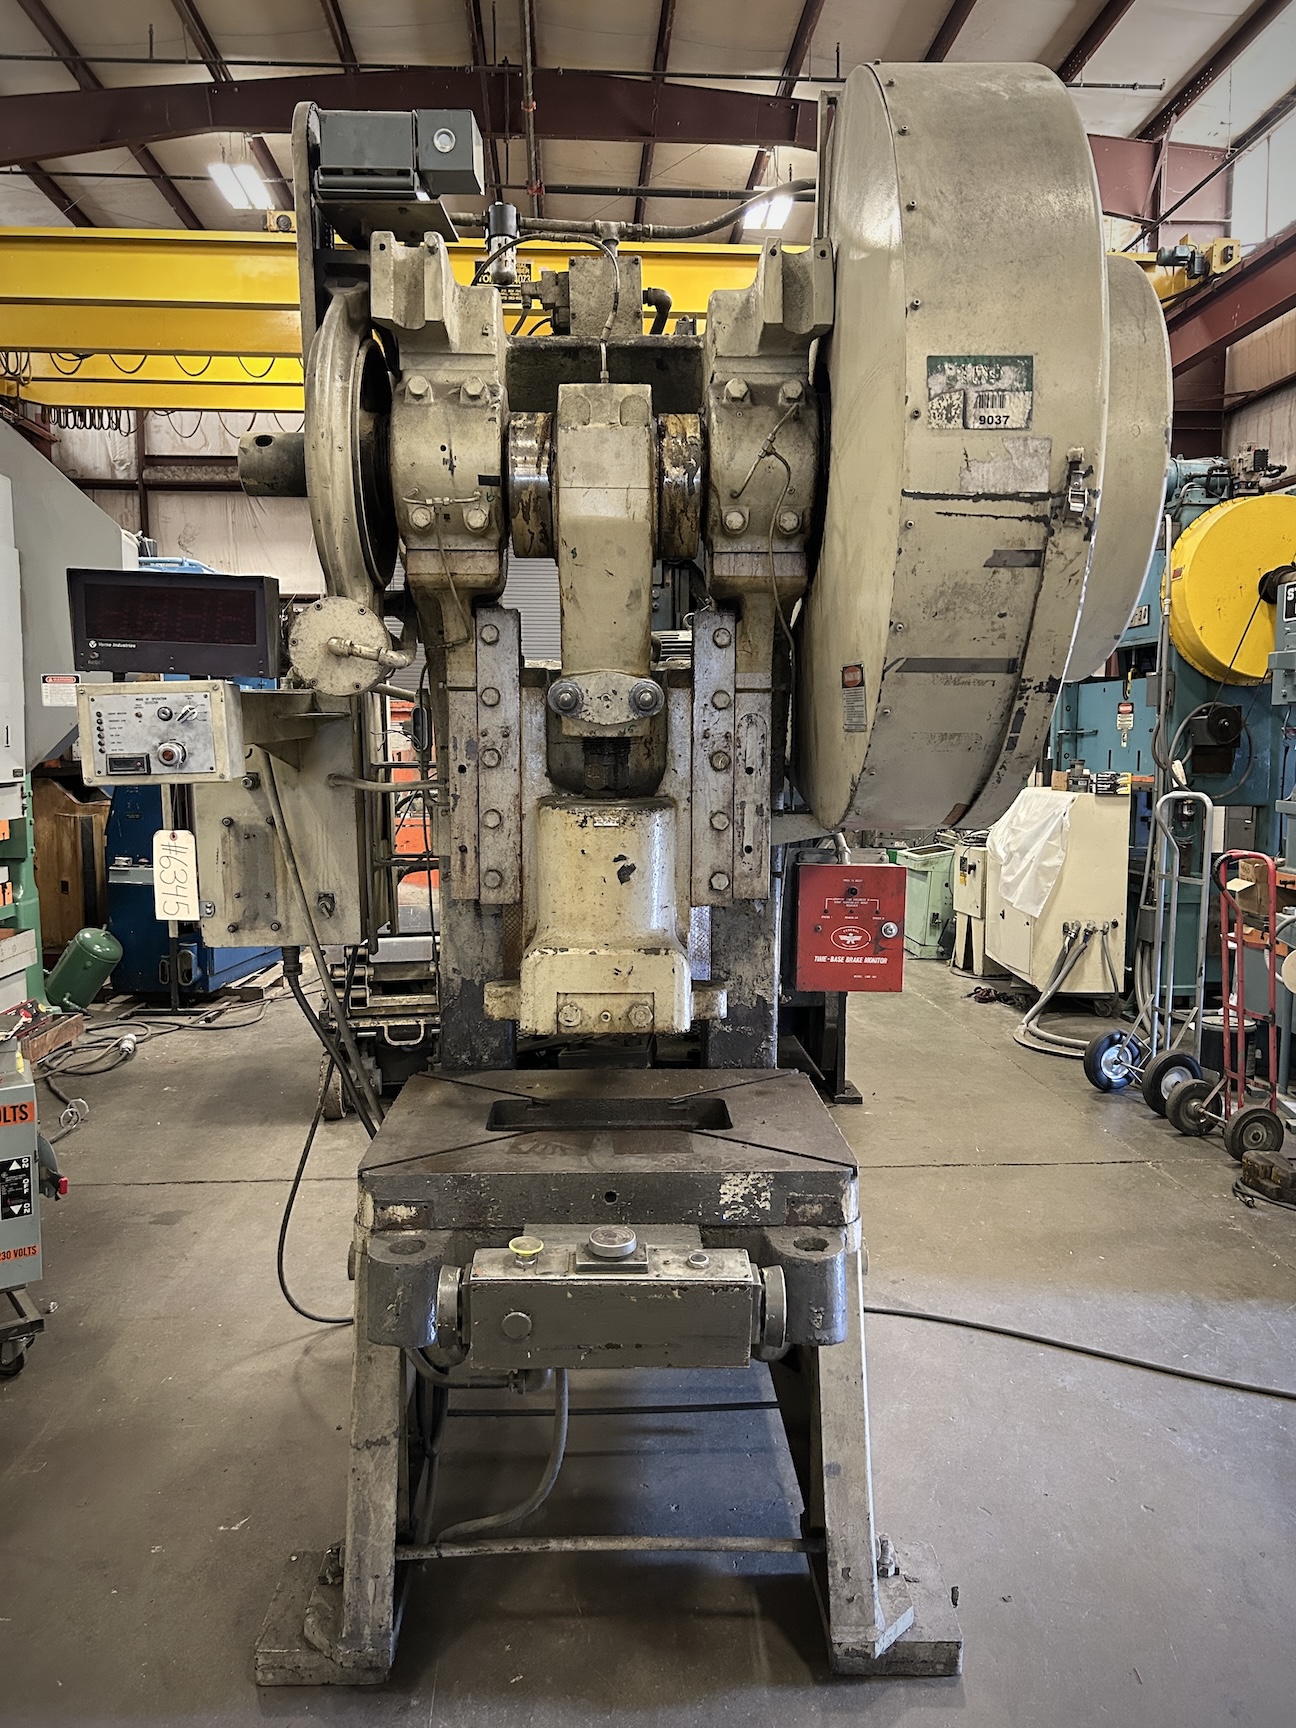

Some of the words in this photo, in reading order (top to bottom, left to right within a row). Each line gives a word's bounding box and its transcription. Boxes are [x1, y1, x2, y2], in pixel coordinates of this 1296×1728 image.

[979, 415, 1010, 425] 9037
[158, 842, 190, 916] #6345
[0, 1104, 28, 1123] LTS
[0, 1250, 12, 1261] 30
[13, 1245, 37, 1258] VOLTS
